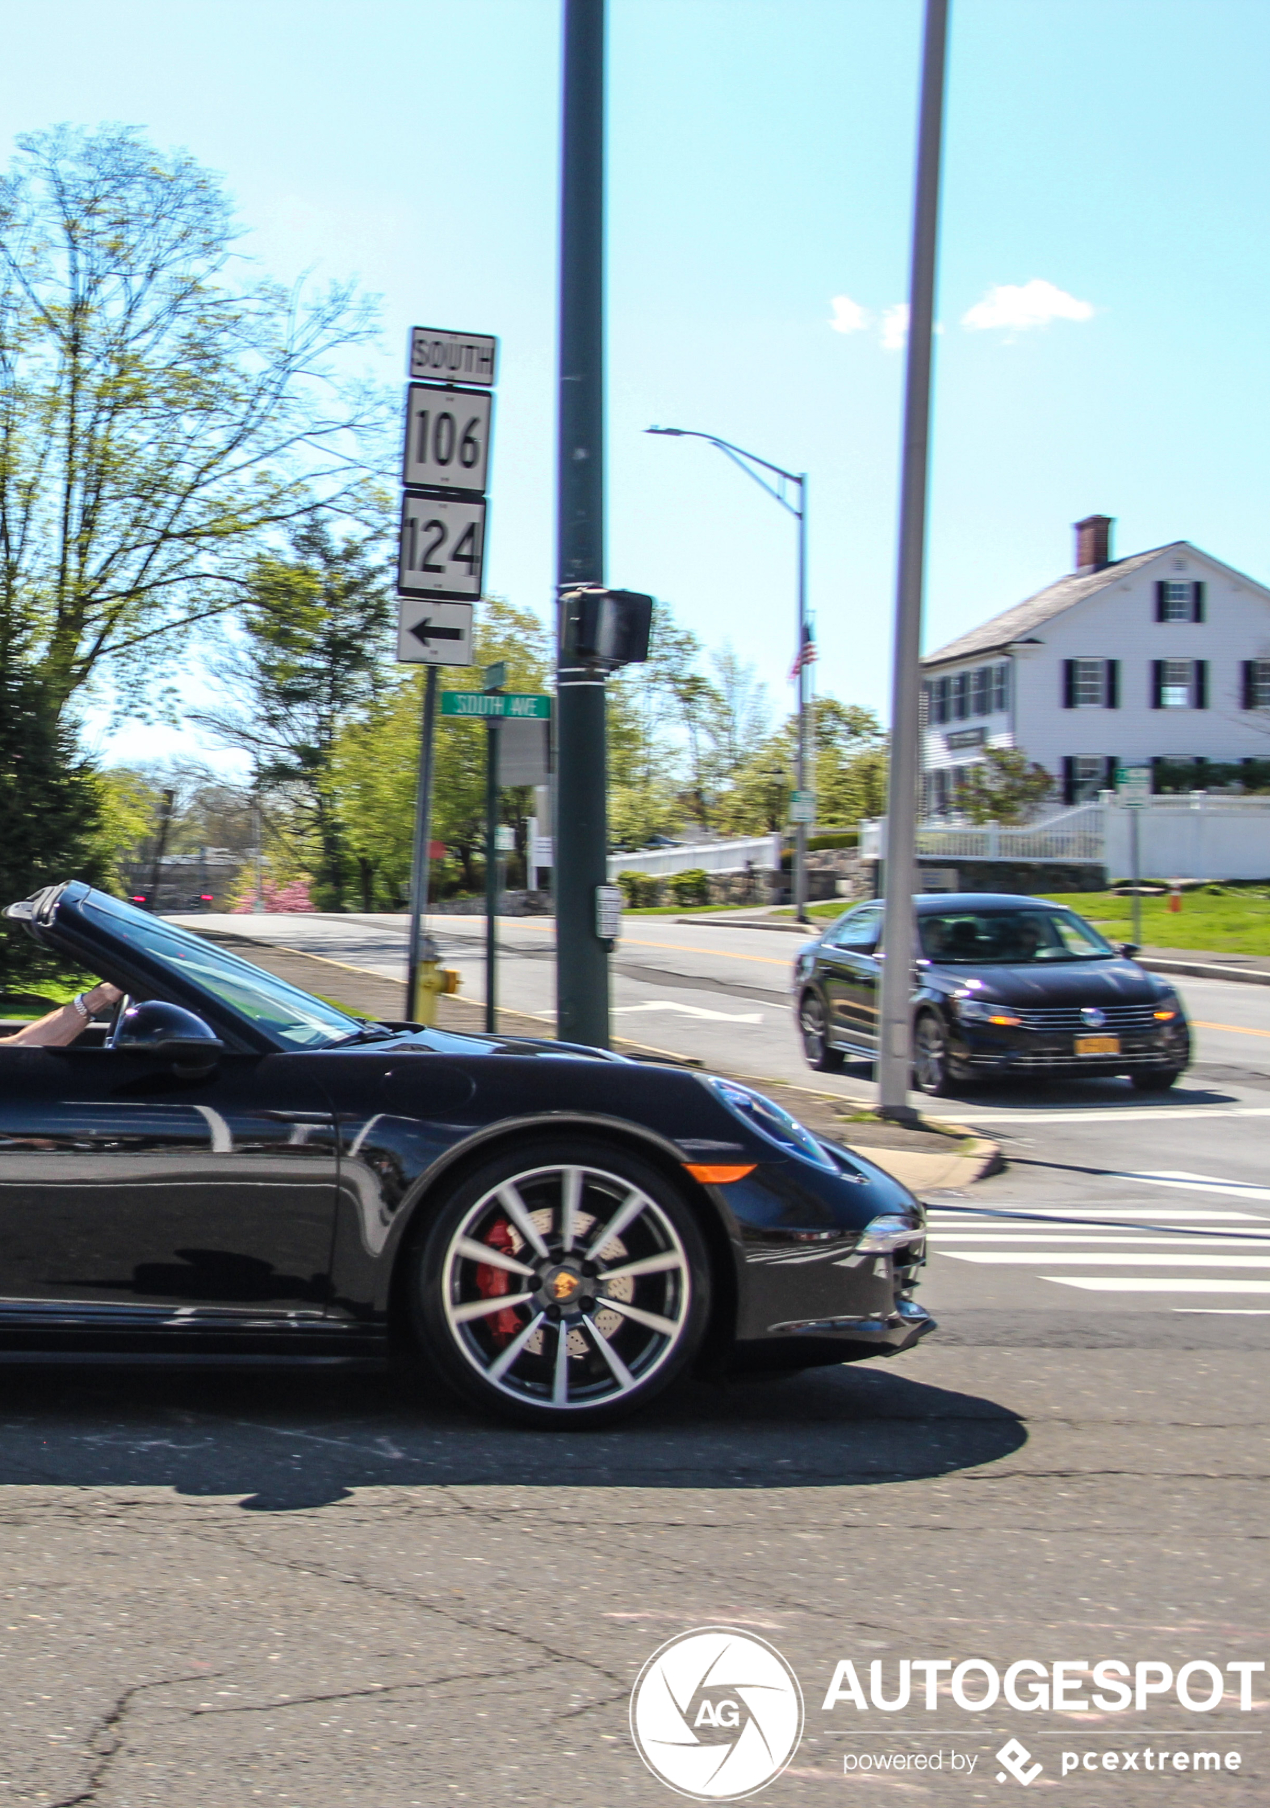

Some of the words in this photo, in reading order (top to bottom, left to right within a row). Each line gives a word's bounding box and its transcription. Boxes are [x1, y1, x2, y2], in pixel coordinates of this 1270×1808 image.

[412, 338, 494, 375] SOUTH
[415, 409, 481, 469] 106
[405, 517, 480, 577] 124
[454, 694, 505, 715] SOUTH
[510, 697, 538, 717] AVE
